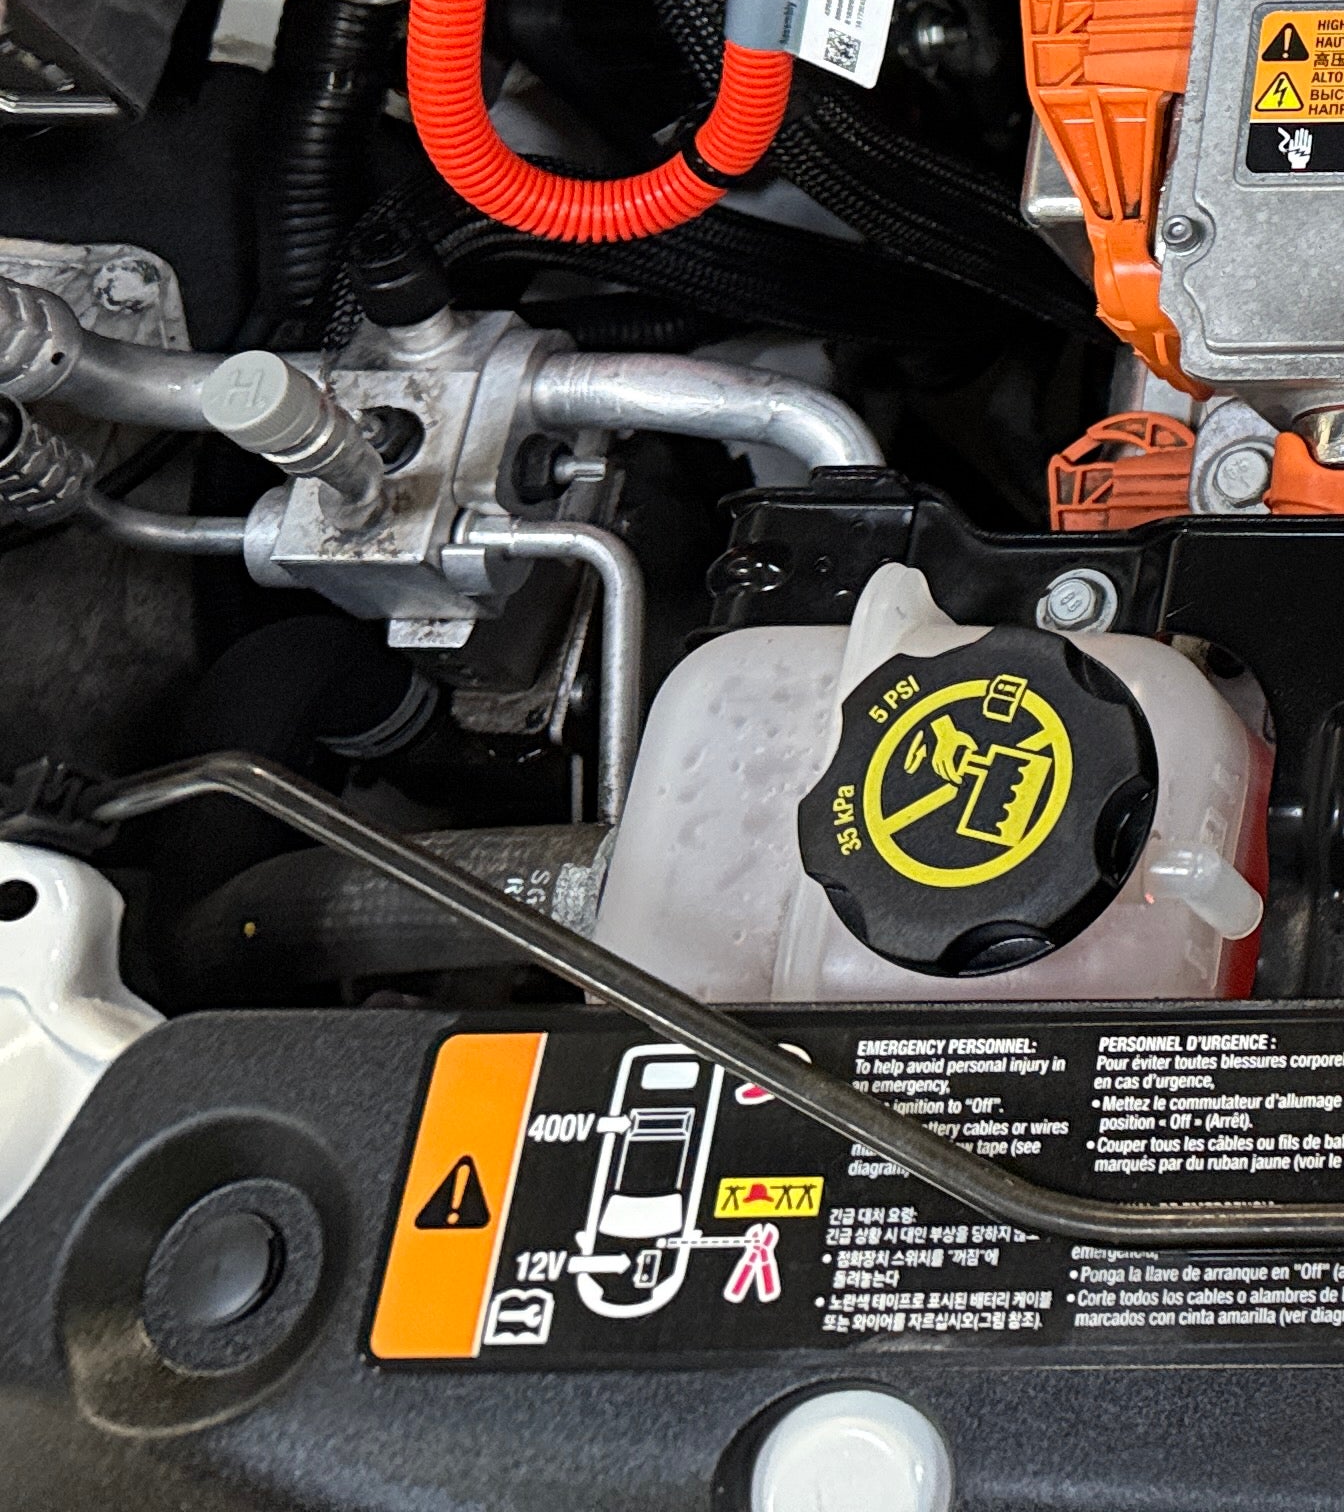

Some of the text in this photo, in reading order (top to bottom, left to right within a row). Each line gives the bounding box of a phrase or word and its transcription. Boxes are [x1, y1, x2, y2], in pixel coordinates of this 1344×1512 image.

[1311, 71, 1344, 83] ALTO
[868, 675, 920, 724] 5 PSI
[832, 784, 862, 856] 35 kPa
[526, 870, 550, 904] SG
[857, 1039, 1038, 1056] EMERGENCY PERSONNEL:
[1099, 1035, 1183, 1052] PERSONNEL
[1186, 1034, 1269, 1051] D’URGENCE
[855, 1056, 1066, 1077] To help avoid personal injury in
[1096, 1055, 1129, 1071] Pour
[1132, 1054, 1172, 1070] éviter
[1175, 1055, 1218, 1069] toutes
[1221, 1054, 1287, 1069] blessures
[852, 1080, 869, 1093] an
[1094, 1076, 1112, 1089] en
[1115, 1076, 1140, 1089] cas
[893, 1099, 945, 1117] ignition
[948, 1099, 962, 1115] to
[1102, 1095, 1150, 1111] Mettez
[1153, 1095, 1167, 1111] le
[1169, 1095, 1263, 1111] commutateur
[1265, 1093, 1343, 1111] d'allumage
[527, 1113, 595, 1143] 400V
[962, 1120, 1009, 1136] cables
[1012, 1122, 1026, 1135] or
[1031, 1119, 1069, 1135] wires
[977, 1141, 1009, 1157] tape
[1011, 1140, 1041, 1157] (see
[829, 1208, 855, 1226] 긴급
[858, 1208, 885, 1225] 대처
[825, 1227, 853, 1246] 긴급
[854, 1227, 883, 1245] 상황
[884, 1227, 899, 1244] 시
[900, 1226, 927, 1244] 대인
[929, 1226, 969, 1244] 부상을
[972, 1225, 1011, 1243] 당하지
[516, 1250, 568, 1283] 12V
[1080, 1266, 1125, 1286] Ponga
[1128, 1265, 1142, 1282] la
[1145, 1265, 1179, 1282] llave
[1182, 1265, 1201, 1281] de
[1203, 1266, 1268, 1284] arranque
[1271, 1266, 1290, 1280] en
[1294, 1262, 1330, 1280] "Off"
[828, 1290, 1053, 1312] 노란색 테이프로 표시된 배터리 케이블
